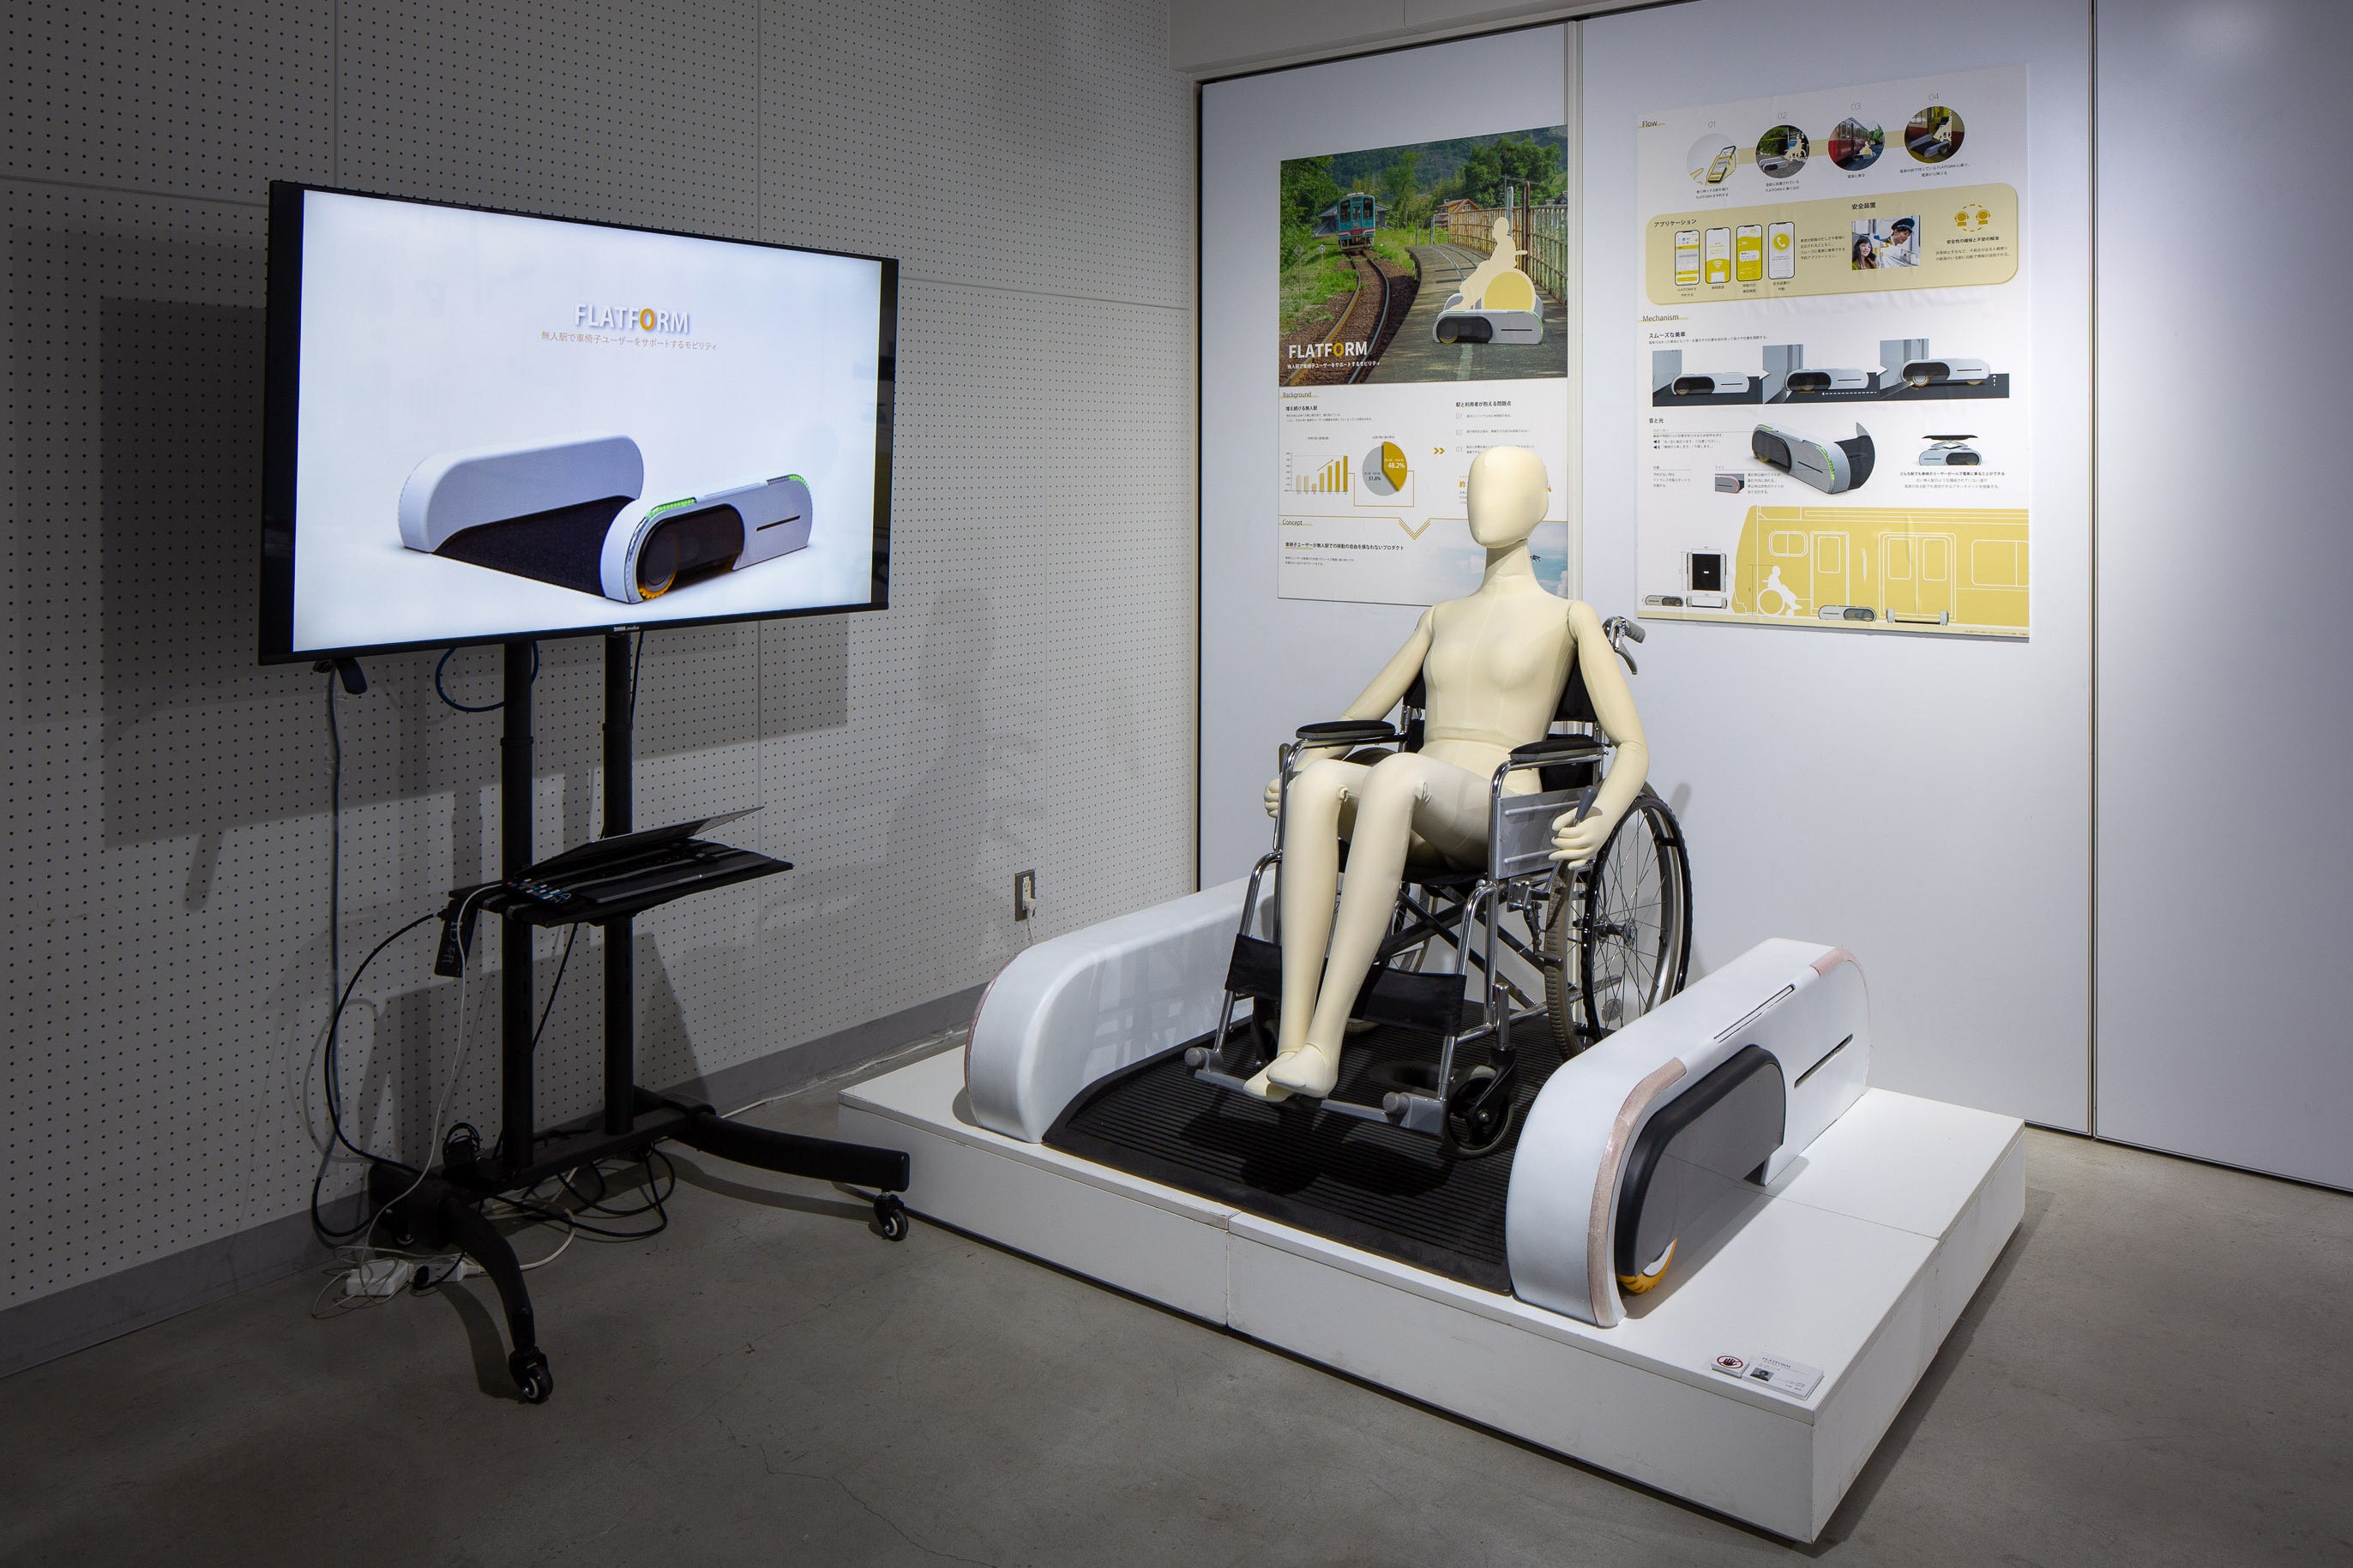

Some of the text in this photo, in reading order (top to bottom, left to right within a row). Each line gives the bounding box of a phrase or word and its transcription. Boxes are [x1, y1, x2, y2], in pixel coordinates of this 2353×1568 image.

[1851, 201, 1876, 210] 安全装置
[1654, 219, 1698, 228] アプリケーション
[575, 303, 689, 333] FLATFORM
[1642, 314, 1679, 322] Mechanism
[541, 330, 717, 351] 無人駅で車椅子ユーザーをサポートするモビリティ
[1288, 341, 1368, 359] FLATFORM
